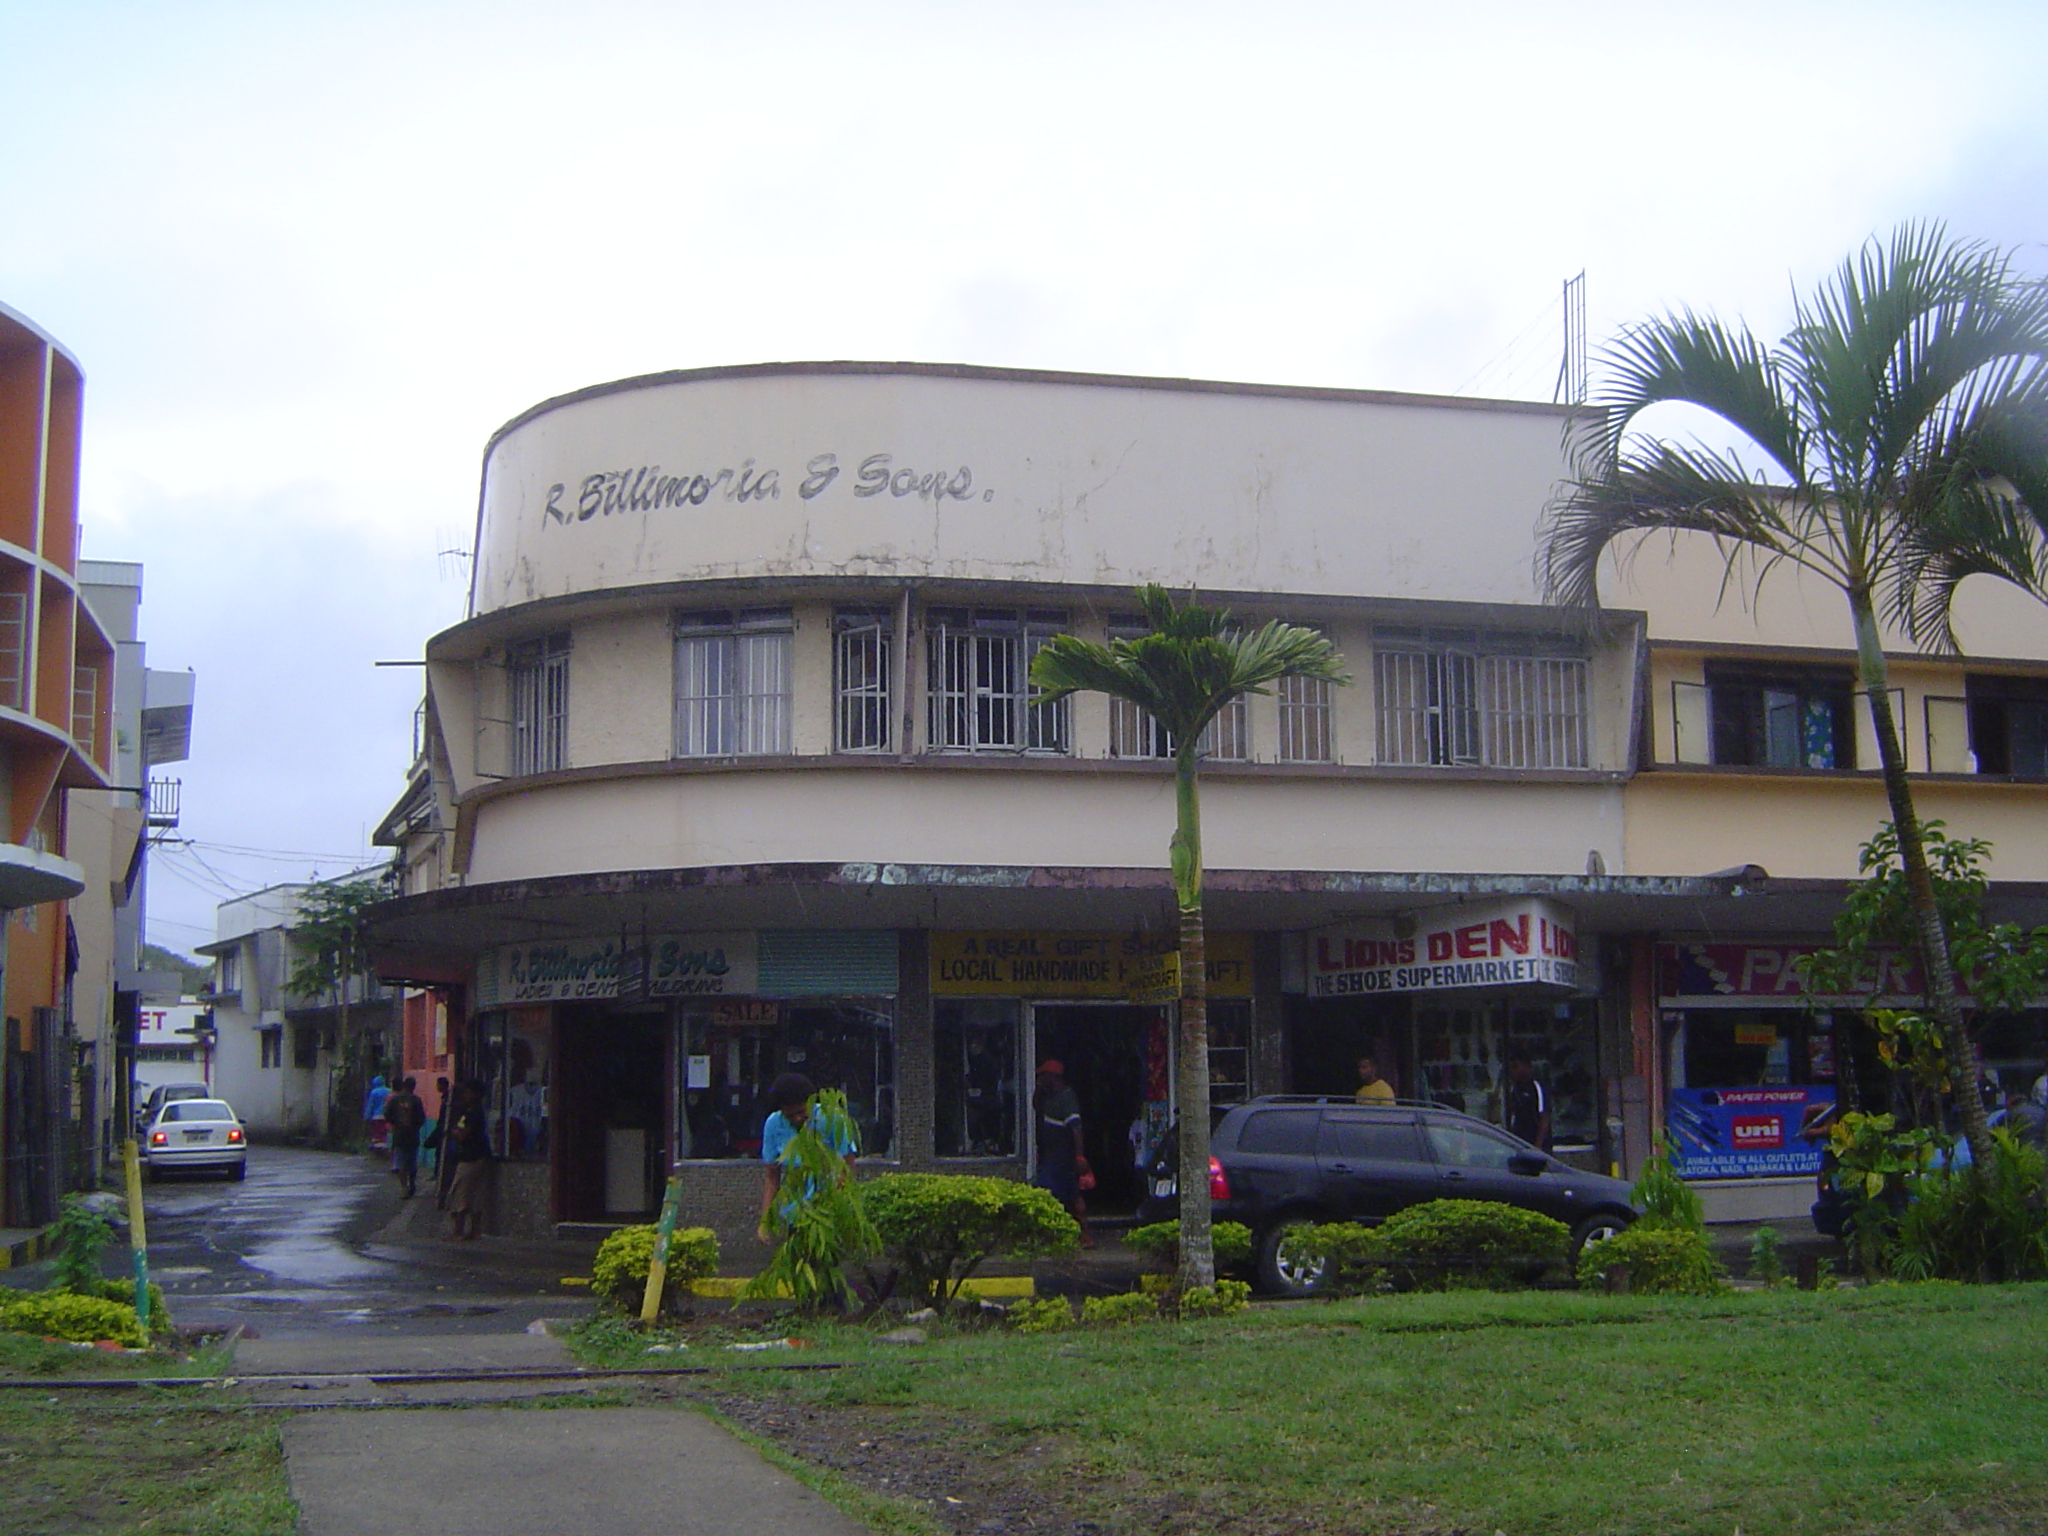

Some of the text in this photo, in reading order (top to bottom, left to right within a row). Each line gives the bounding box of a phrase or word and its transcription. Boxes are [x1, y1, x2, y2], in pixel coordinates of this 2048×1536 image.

[799, 452, 840, 500] &
[1317, 913, 1531, 971] LIONS DEN
[940, 959, 1001, 982] LOCAL
[1012, 959, 1109, 982] HANDMADE
[1337, 970, 1392, 992] SHOE
[1396, 958, 1538, 988] SUPERMARKET
[1741, 948, 1909, 993] PAER
[1726, 1091, 1804, 1102] PAPER POWER
[1735, 1119, 1780, 1138] uni
[1749, 1154, 1765, 1164] ALL
[1766, 1153, 1807, 1163] OUTLETS
[1808, 1152, 1818, 1162] AT
